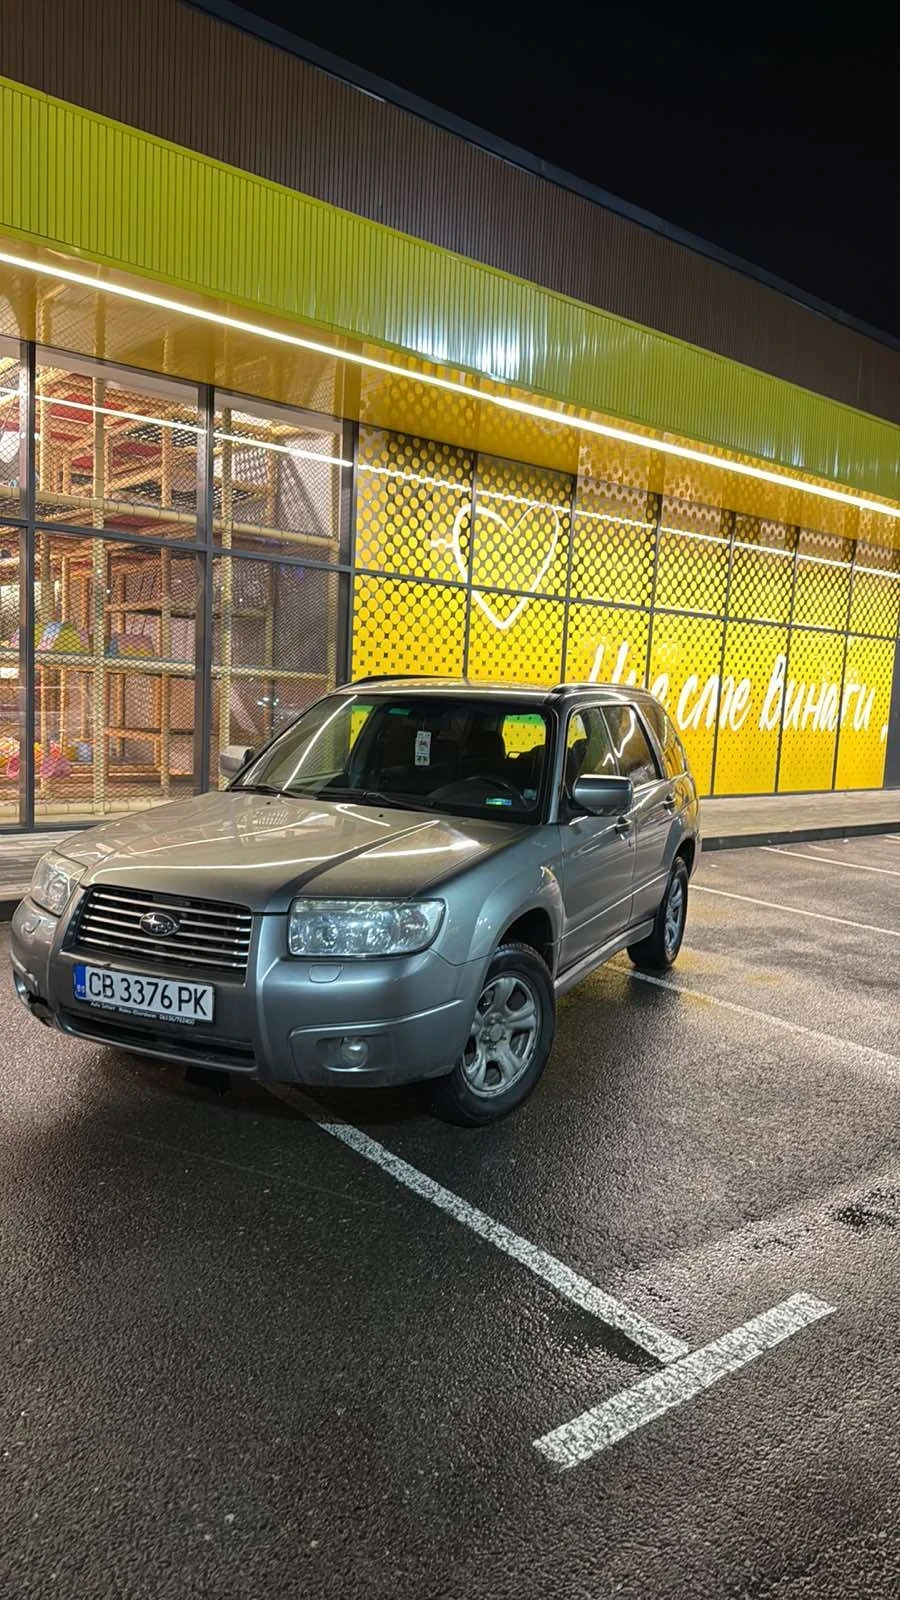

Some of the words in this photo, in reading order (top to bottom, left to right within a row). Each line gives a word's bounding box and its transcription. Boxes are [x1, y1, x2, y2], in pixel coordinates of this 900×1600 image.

[89, 972, 115, 999] CB
[119, 977, 173, 1009] 3376
[178, 986, 208, 1016] PK
